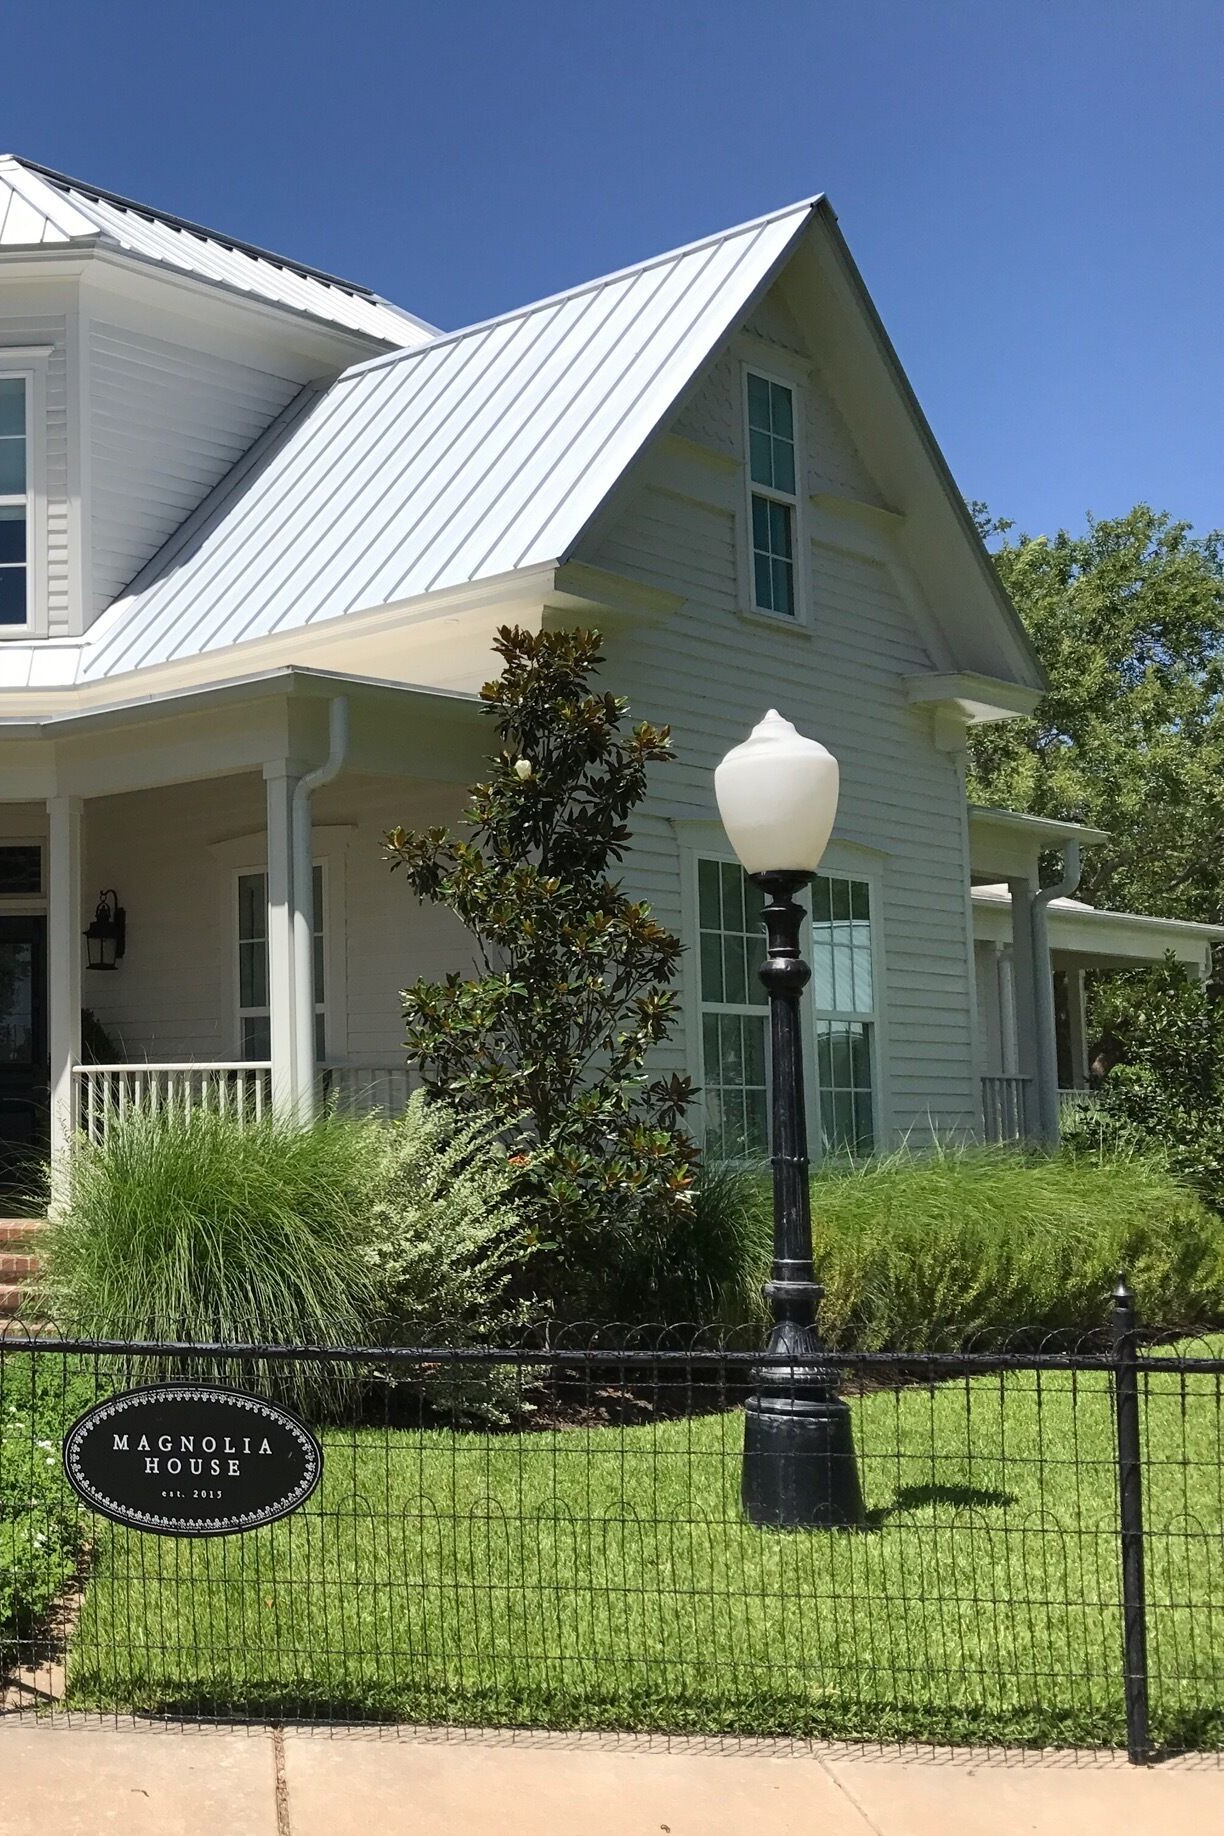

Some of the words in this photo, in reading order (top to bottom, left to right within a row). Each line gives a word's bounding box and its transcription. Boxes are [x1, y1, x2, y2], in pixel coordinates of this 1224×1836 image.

[112, 1434, 273, 1454] MAGNOLIA
[144, 1457, 241, 1476] HOUSE
[162, 1490, 185, 1498] est.
[193, 1490, 222, 1499] 2015
